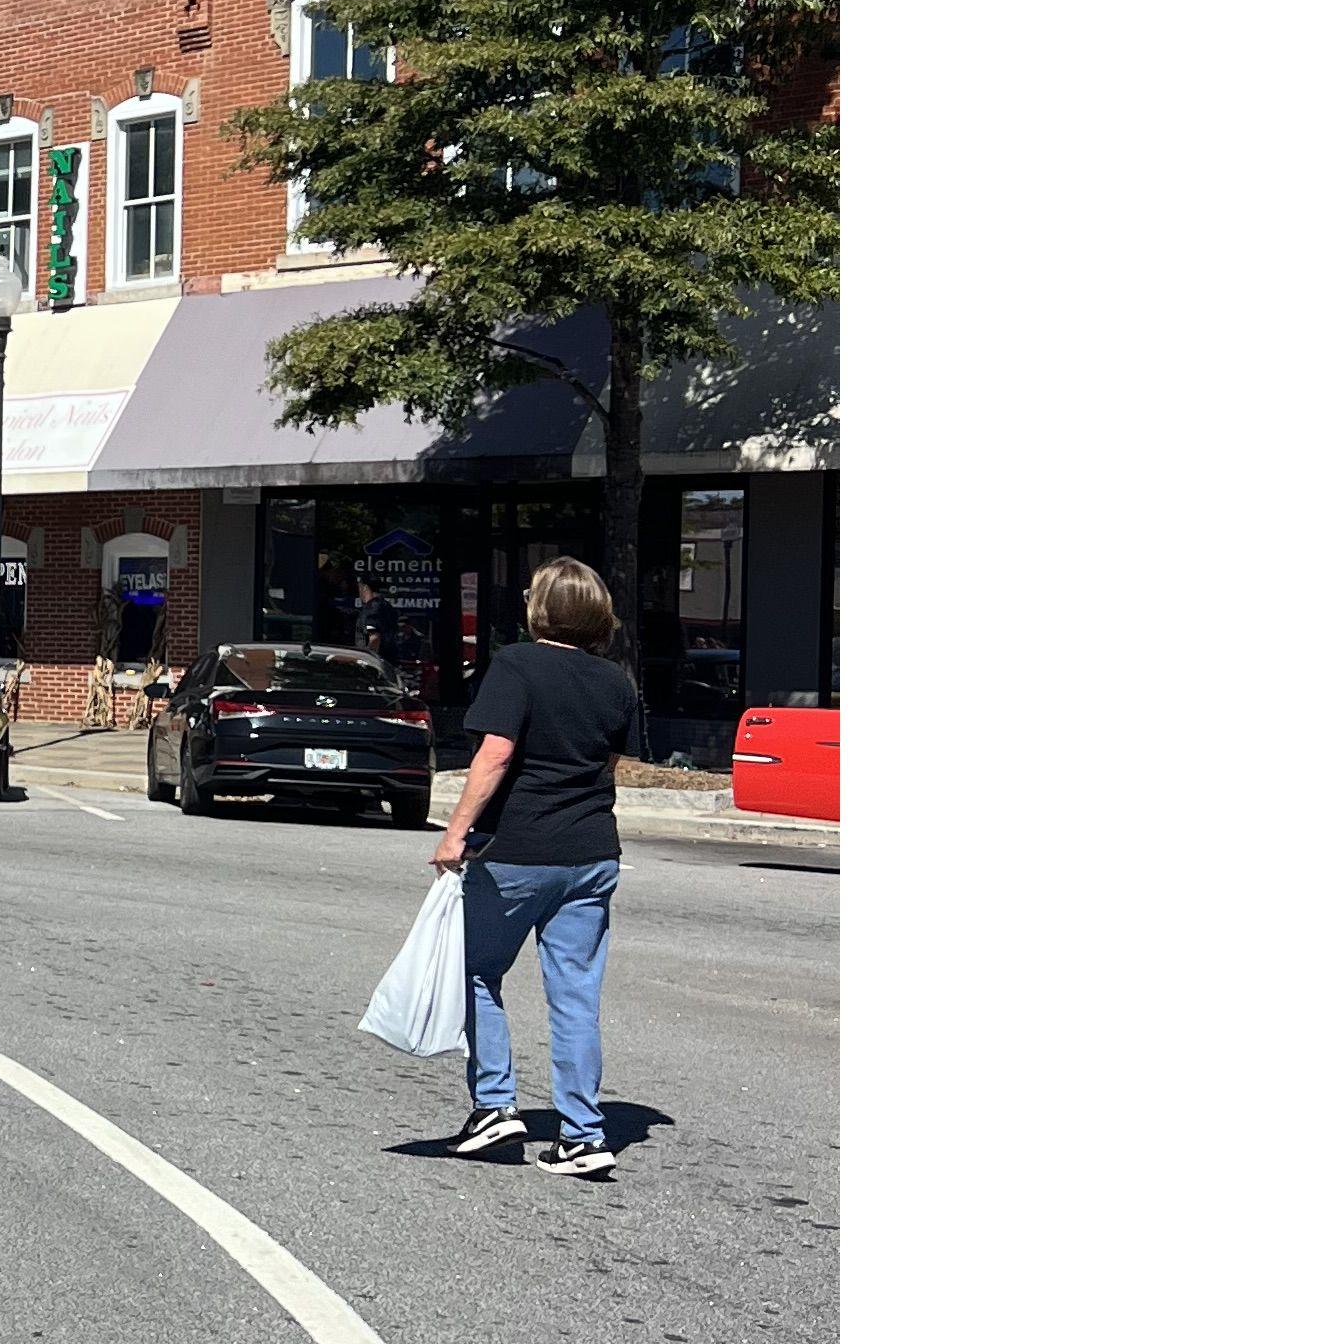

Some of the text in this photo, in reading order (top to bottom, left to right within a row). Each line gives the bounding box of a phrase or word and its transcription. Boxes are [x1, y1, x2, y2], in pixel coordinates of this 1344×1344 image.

[48, 148, 75, 299] NAILS
[51, 400, 111, 430] Nails
[354, 556, 443, 572] element
[119, 573, 167, 591] EYELAS
